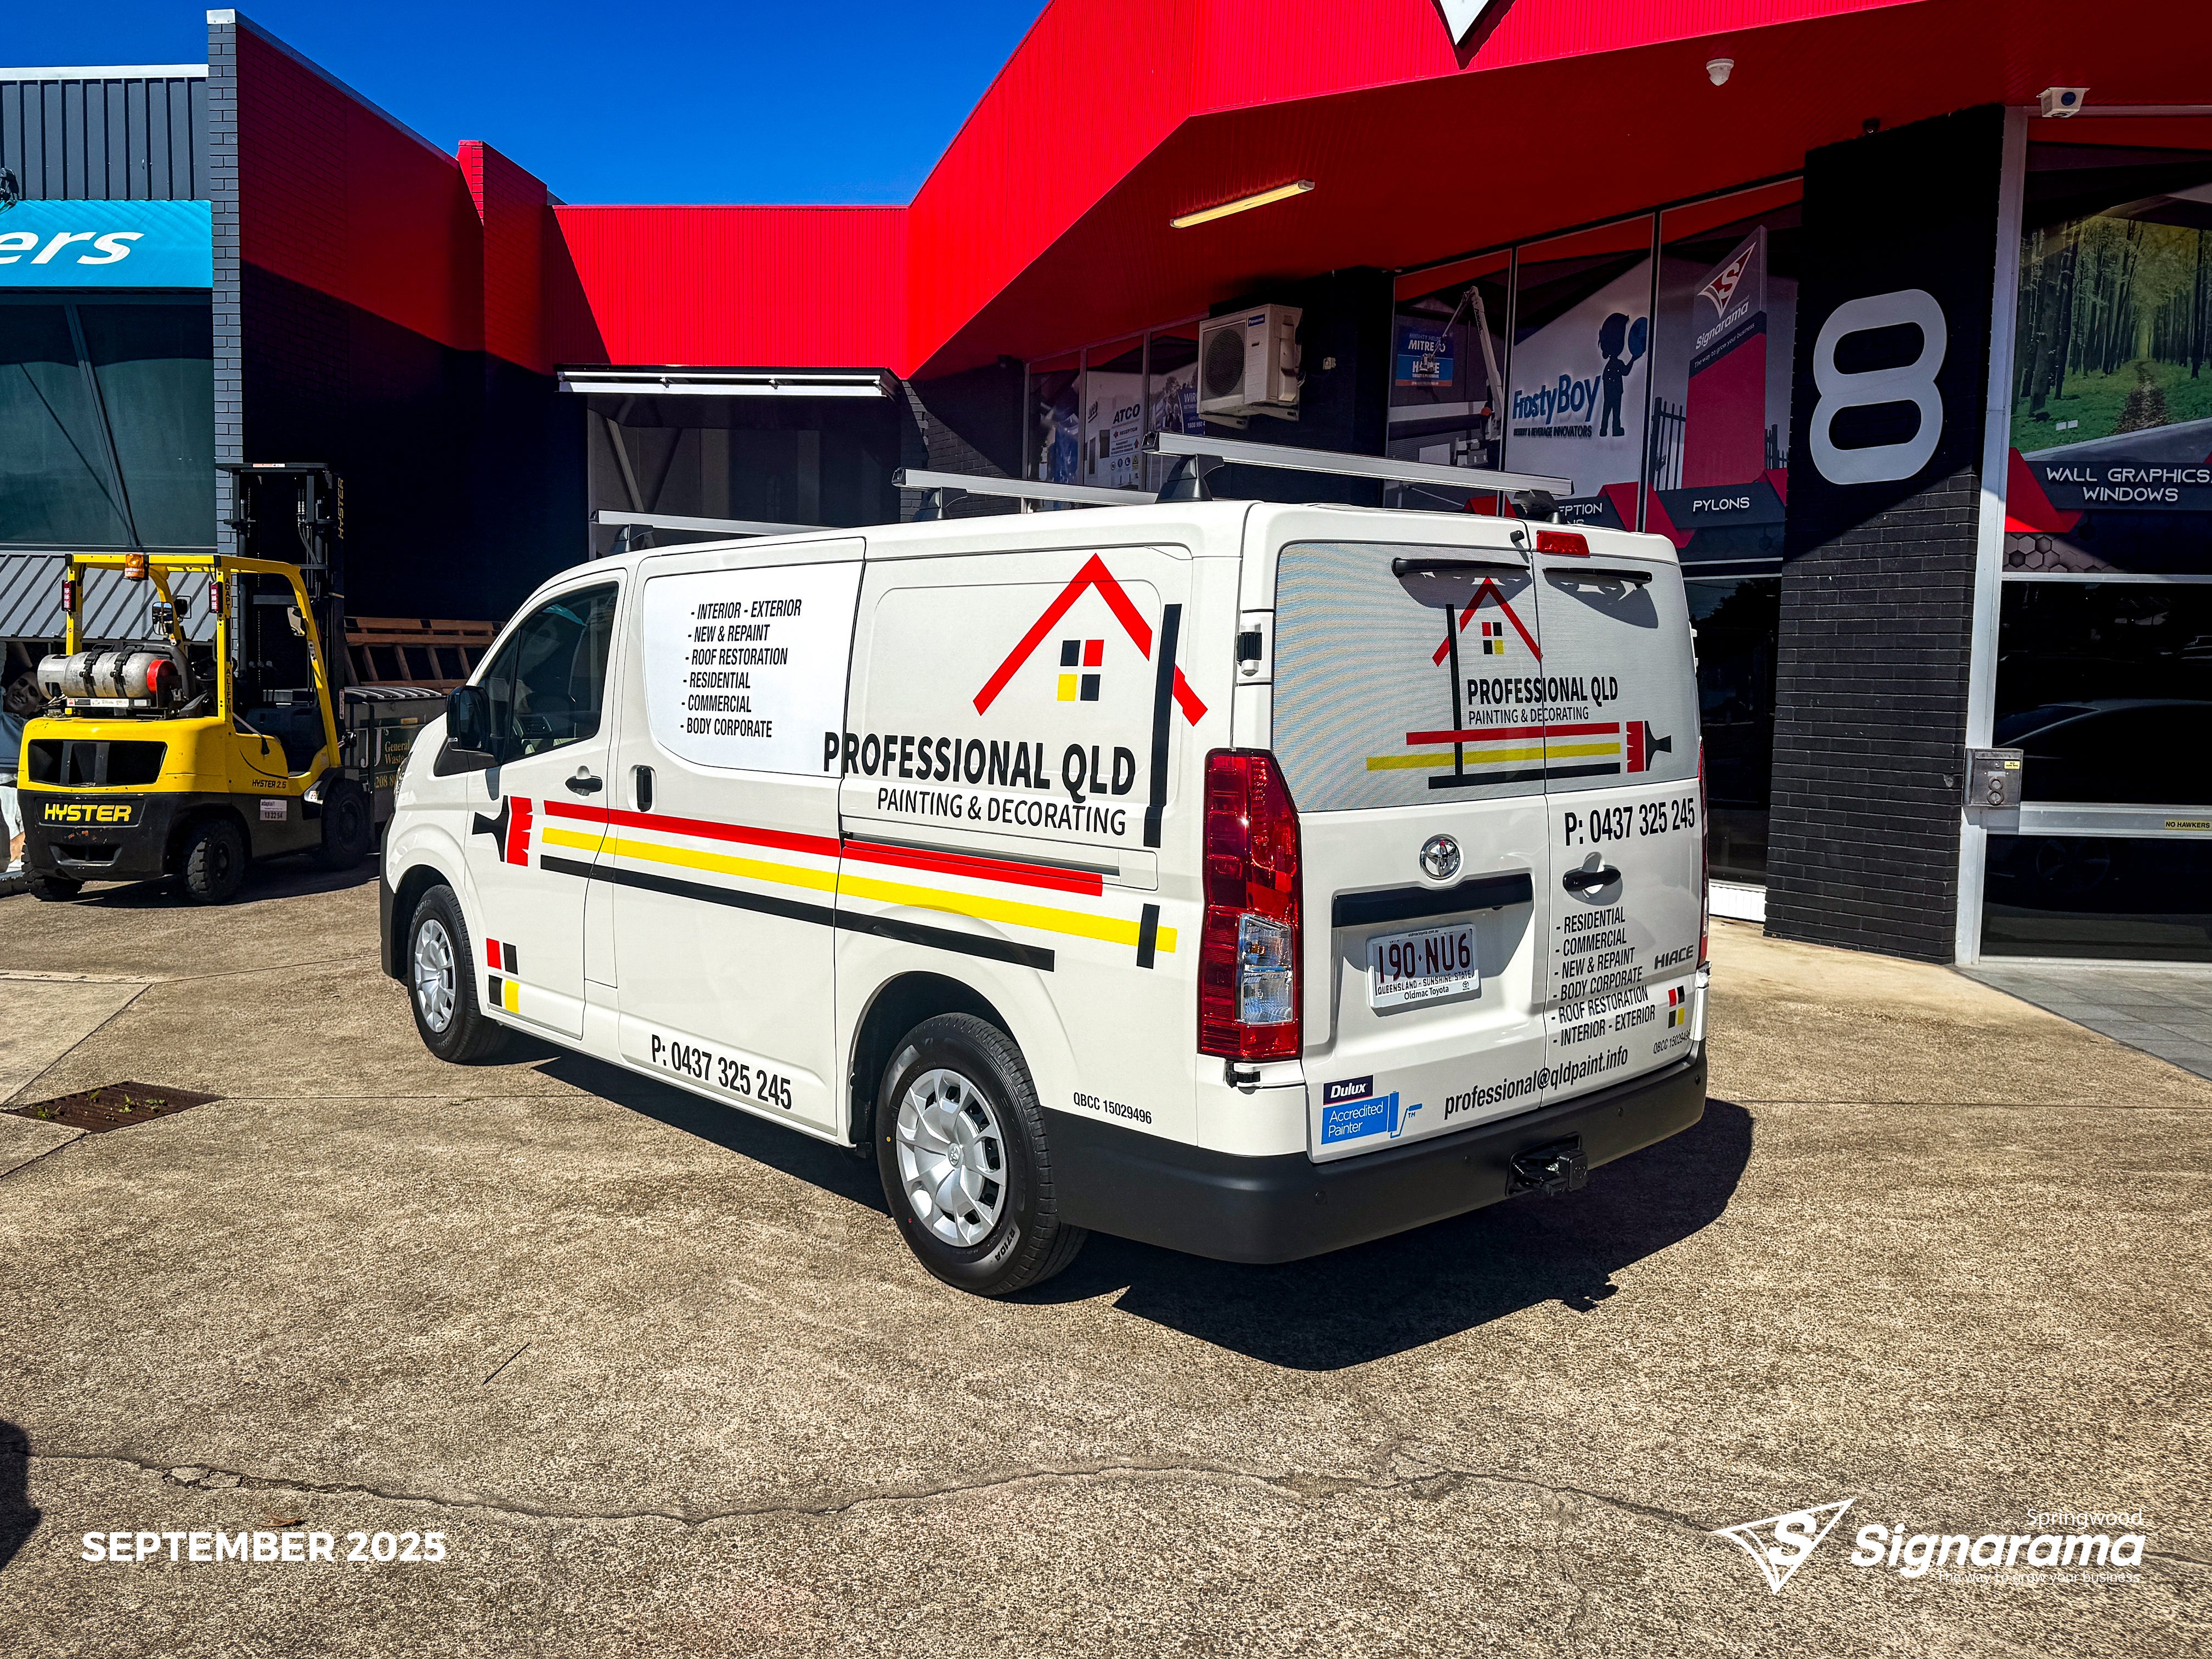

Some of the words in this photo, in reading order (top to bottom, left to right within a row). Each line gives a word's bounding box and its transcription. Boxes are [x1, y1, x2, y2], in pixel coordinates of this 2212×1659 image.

[1696, 301, 1748, 350] Signarama
[1408, 340, 1435, 351] MITRE
[1702, 354, 1711, 365] way
[1711, 349, 1716, 357] to
[1716, 343, 1726, 354] grow
[1726, 338, 1736, 348] your
[1737, 323, 1754, 341] business
[1413, 361, 1440, 373] HE
[1810, 289, 1947, 485] 8
[1113, 404, 1140, 424] ATCO
[1119, 427, 1138, 436] RECEPTION
[1553, 425, 1592, 437] INNOVATORS
[2046, 467, 2097, 482] WALL
[1693, 496, 1750, 512] PYLONS
[2083, 487, 2179, 501] WINDOWS
[1558, 503, 1602, 516] EPTION
[697, 602, 741, 619] INTERIOR
[751, 599, 802, 618] EXTERIOR
[695, 625, 716, 642] NEW
[718, 625, 725, 642] &
[727, 624, 770, 642] REPAINT
[691, 648, 717, 665] ROOF
[719, 647, 788, 665] RESTORATION
[690, 672, 751, 689] RESIDENTIAL
[1467, 676, 1588, 705] PROFESSIONAL
[1591, 676, 1618, 707] QLD
[688, 694, 751, 713] COMMERCIAL
[1469, 709, 1518, 725] PAINTING
[1521, 712, 1528, 723] &
[1530, 706, 1589, 723] DECORATING
[687, 717, 712, 734] BODY
[714, 718, 772, 738] CORPORATE
[385, 740, 410, 753] General
[823, 731, 1050, 789] PROFESSIONAL
[1062, 743, 1136, 804] QLD
[252, 779, 275, 788] HYSTER
[1987, 777, 2004, 806] 8
[44, 803, 132, 822] HYSTER
[878, 788, 962, 817] PAINTING
[967, 796, 981, 821] &
[988, 797, 1126, 836] DECORATING
[1565, 812, 1583, 846] P:
[1590, 806, 1633, 843] 0437
[1639, 802, 1667, 836] 325
[1671, 798, 1695, 831] 245
[1564, 906, 1626, 934] RESIDENTIAL
[1563, 928, 1627, 957] COMMERCIAL
[1562, 958, 1585, 979] NEW
[1587, 957, 1594, 973] &
[1597, 947, 1635, 971] REPAINT
[1654, 945, 1694, 969] HIACE
[1378, 980, 1417, 995] QUEENSLAND
[1423, 973, 1453, 986] SUNSHINE
[1454, 970, 1471, 981] STATE
[1404, 989, 1429, 1000] Oldmac
[1430, 985, 1449, 997] Toyota
[1560, 979, 1588, 1001] BODY
[1590, 966, 1643, 994] CORPORATE
[1559, 1001, 1585, 1024] ROOF
[1588, 984, 1649, 1018] RESTORATION
[1561, 1018, 1605, 1047] INTERIOR
[1615, 1004, 1655, 1031] EXTERIOR
[1653, 1038, 1668, 1054] QBCC
[652, 1034, 667, 1066] P:
[671, 1041, 712, 1081] 0437
[718, 1057, 751, 1096] 325
[756, 1069, 792, 1110] 245
[1330, 1082, 1367, 1099] Dulux
[1444, 1046, 1628, 1120] professional@qldpaint.info
[1074, 1092, 1100, 1110] QBCC
[1103, 1099, 1152, 1124] 15029496
[1329, 1101, 1384, 1123] Accredited
[1328, 1121, 1363, 1137] Painter
